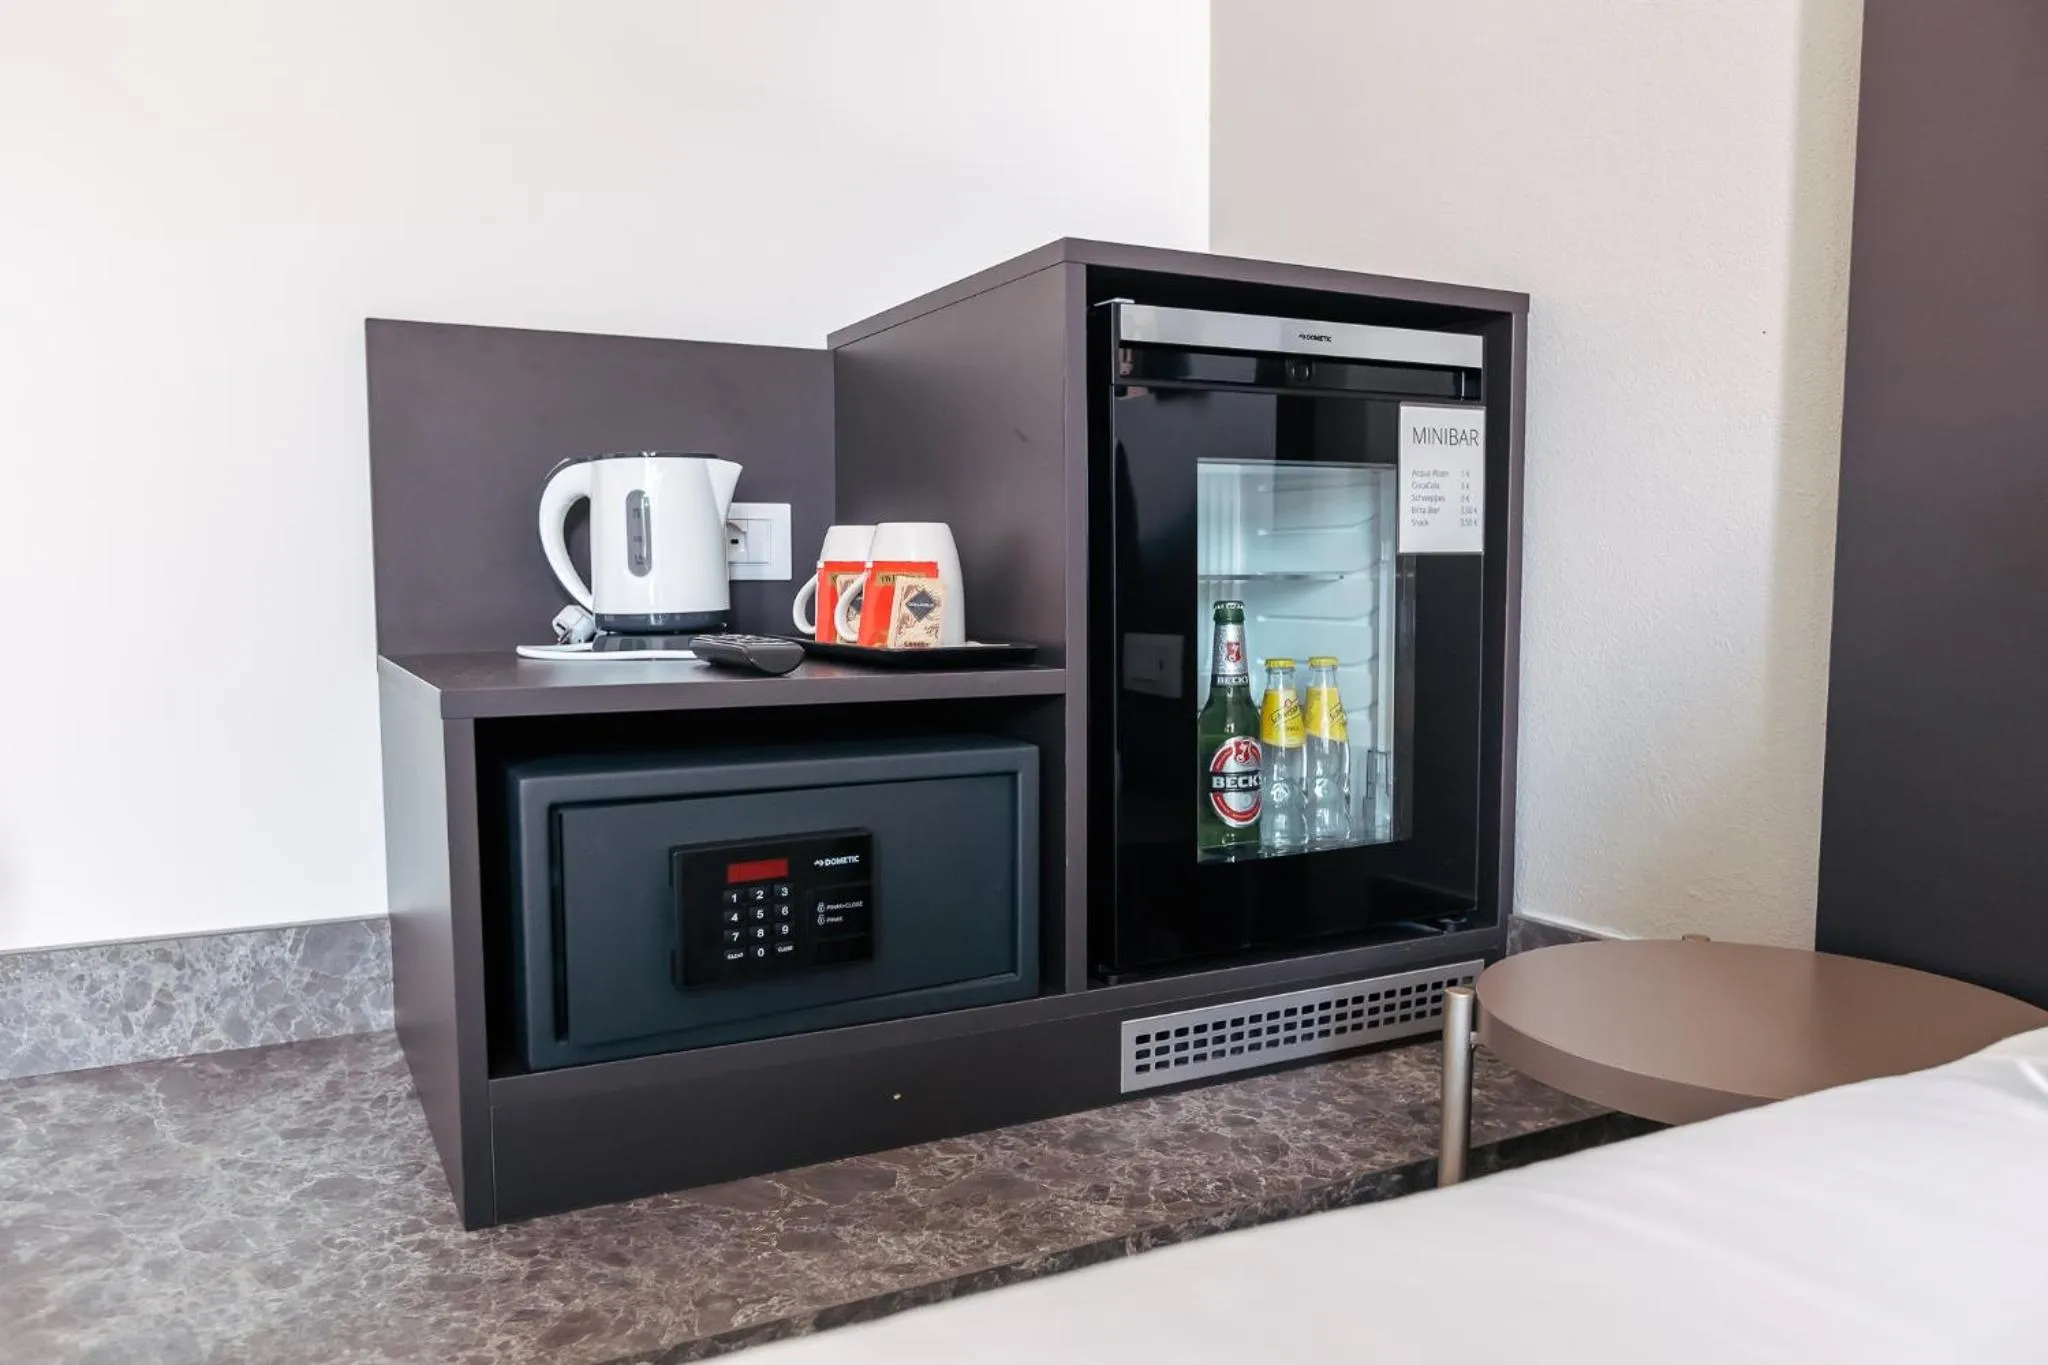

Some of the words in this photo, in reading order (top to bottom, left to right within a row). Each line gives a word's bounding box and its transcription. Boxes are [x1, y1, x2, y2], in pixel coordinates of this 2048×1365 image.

[1306, 334, 1332, 343] DOMETIC
[1412, 426, 1480, 447] MINIBAR
[1212, 775, 1261, 789] BECK
[825, 855, 860, 866] DOMETIC
[731, 893, 738, 903] 1
[755, 890, 764, 900] 2
[781, 886, 789, 897] 3
[730, 912, 739, 922] 4
[756, 909, 765, 919] 5
[781, 906, 789, 916] 6
[731, 932, 740, 942] 7
[756, 928, 765, 939] 8
[781, 925, 789, 935] 9
[757, 947, 765, 958] 0
